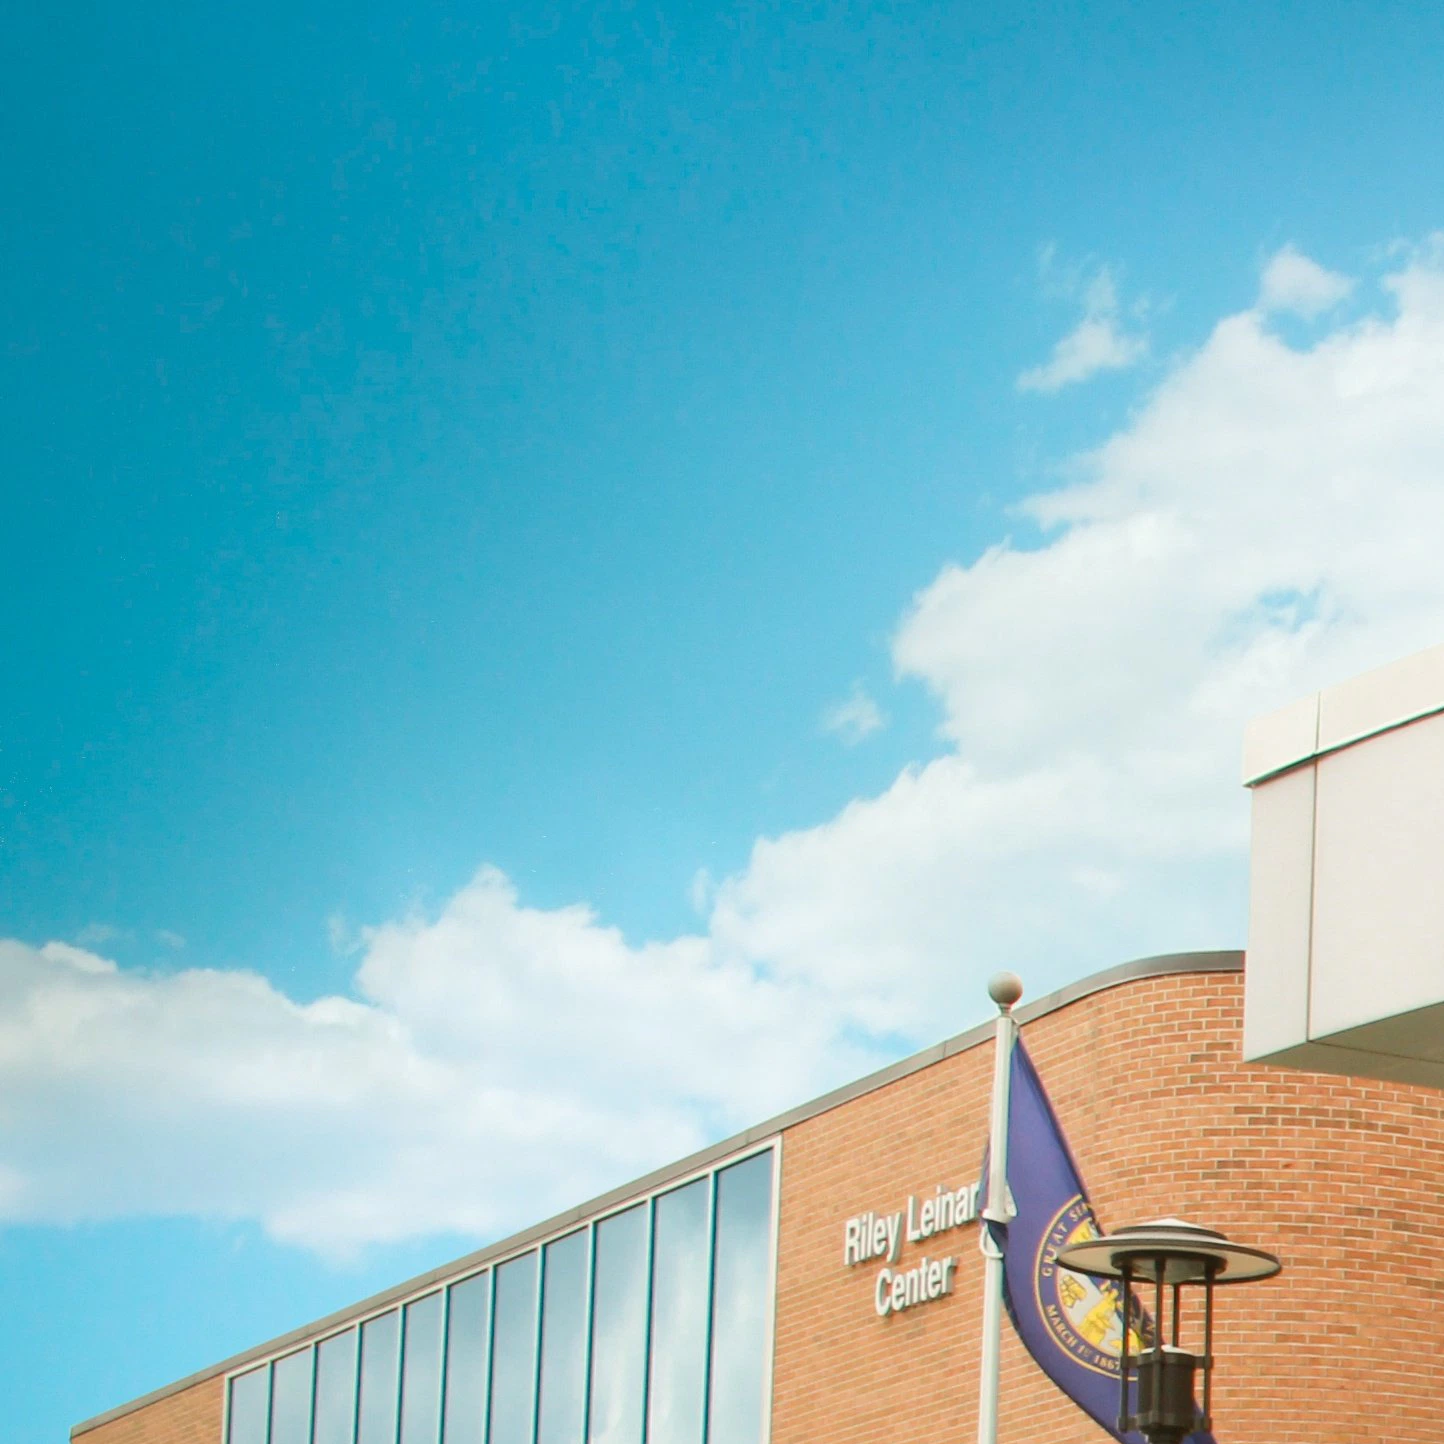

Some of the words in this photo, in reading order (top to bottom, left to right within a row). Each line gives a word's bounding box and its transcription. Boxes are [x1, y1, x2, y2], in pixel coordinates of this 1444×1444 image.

[844, 1211, 903, 1266] Riley
[906, 1181, 981, 1243] Leinar
[874, 1255, 956, 1317] Center
[1045, 1303, 1079, 1348] MARCH
[1093, 1354, 1121, 1371] 1867
